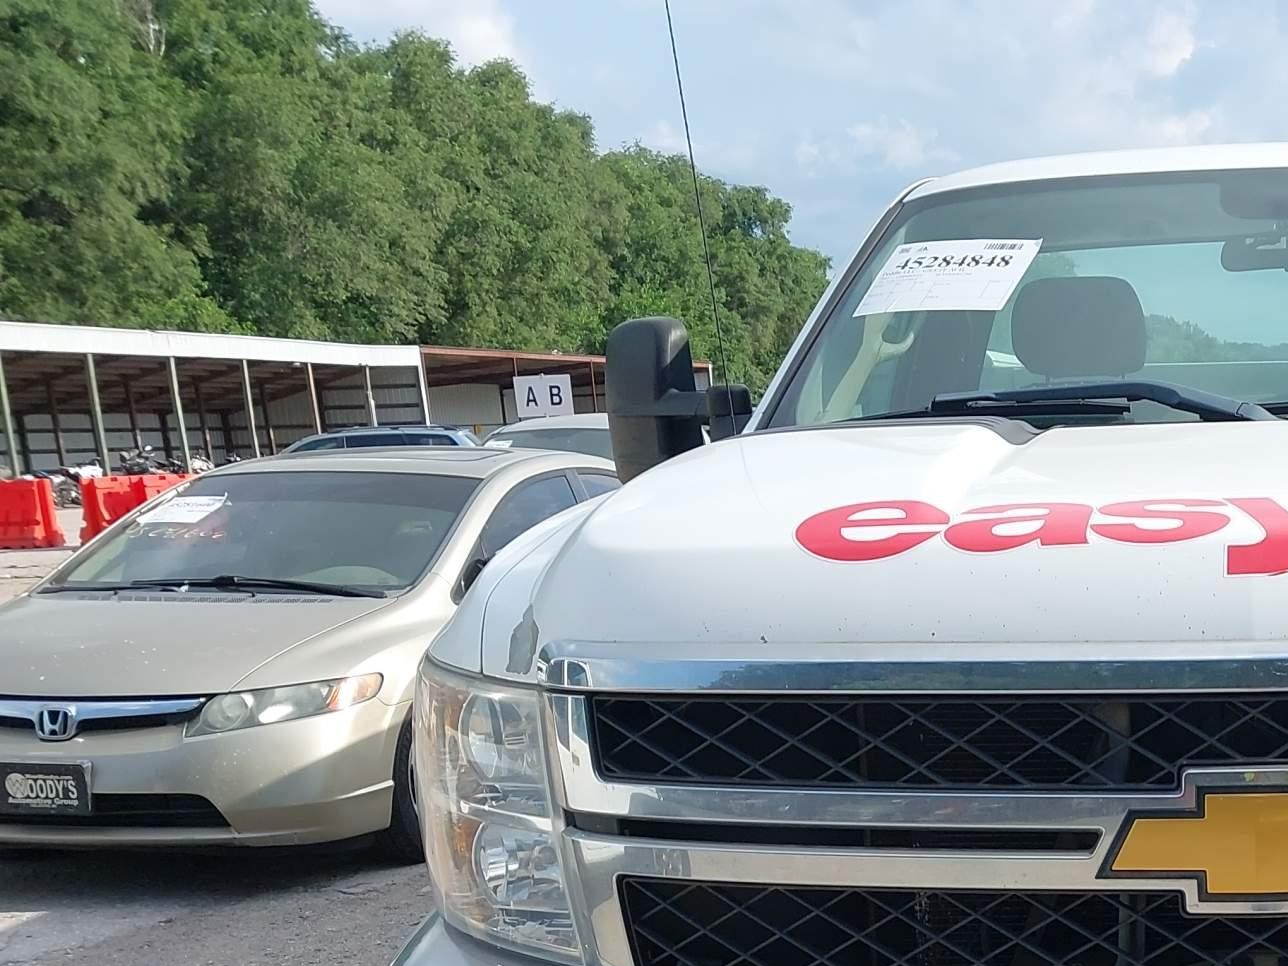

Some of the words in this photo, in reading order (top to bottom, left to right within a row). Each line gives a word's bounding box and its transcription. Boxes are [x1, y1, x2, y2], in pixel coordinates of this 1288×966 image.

[896, 254, 1014, 270] 45284848
[526, 386, 539, 407] A
[549, 385, 563, 406] B
